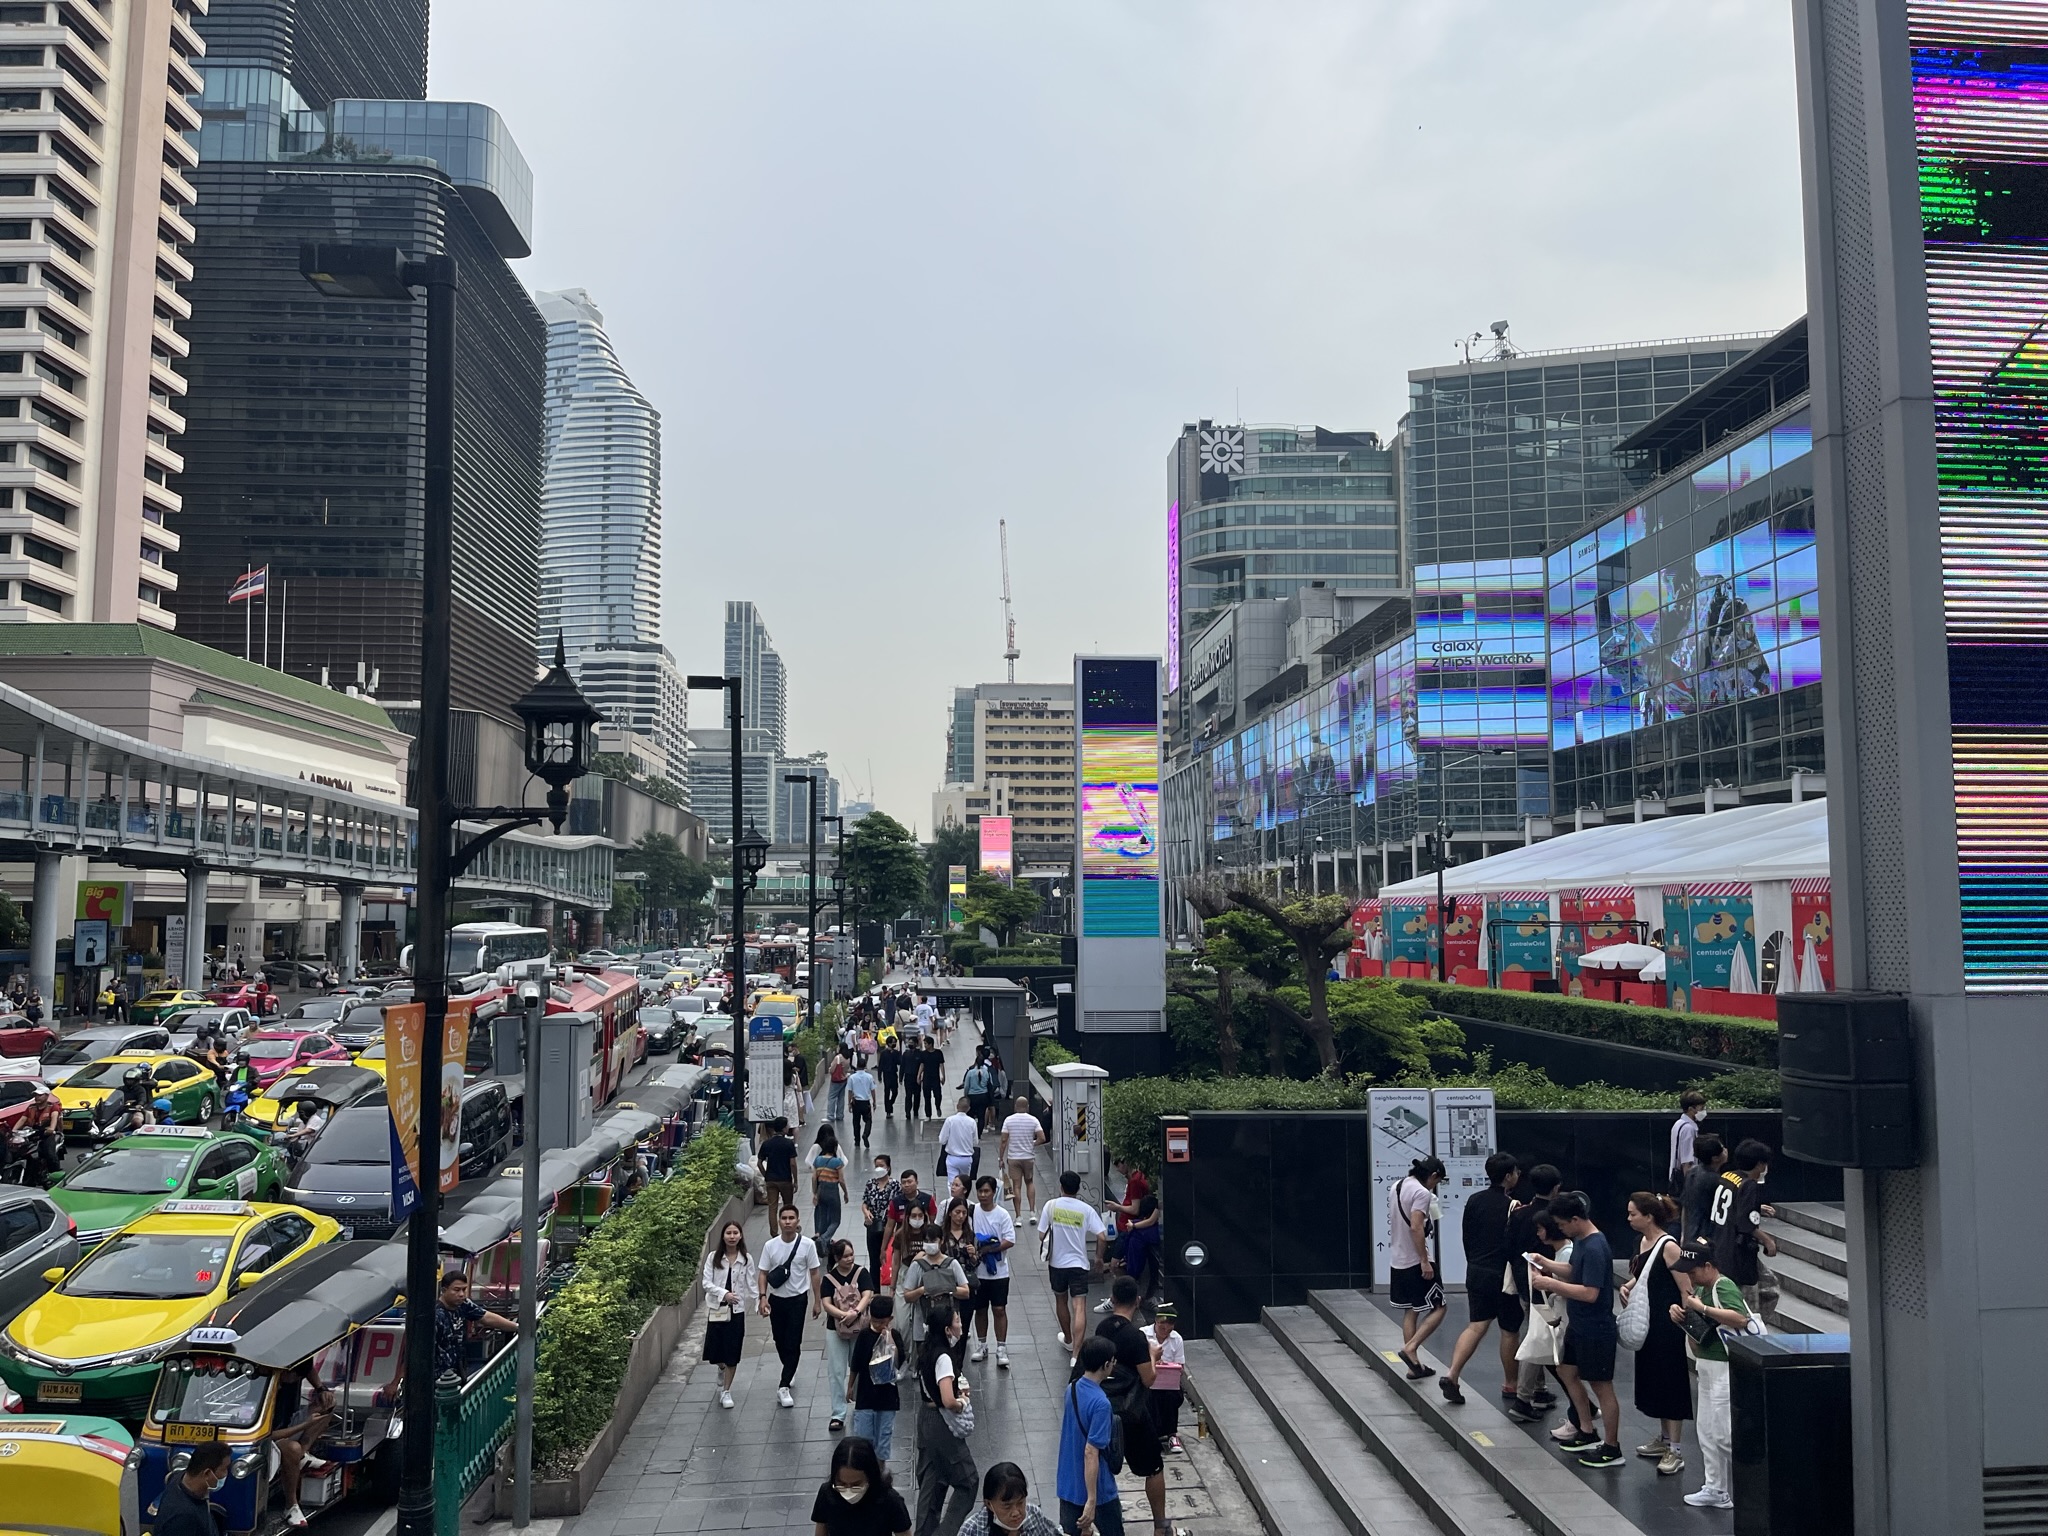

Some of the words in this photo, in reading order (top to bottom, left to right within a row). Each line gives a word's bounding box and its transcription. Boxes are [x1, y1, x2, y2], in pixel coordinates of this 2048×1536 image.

[1432, 640, 1483, 654] Galaxy
[1479, 653, 1533, 666] Watch6
[85, 887, 104, 898] Big
[440, 1171, 452, 1186] VISA
[402, 1190, 415, 1207] VISA
[1710, 1184, 1733, 1226] 13
[196, 1330, 225, 1340] TAXI
[60, 1385, 79, 1395] 3424
[190, 1426, 214, 1438] 7398
